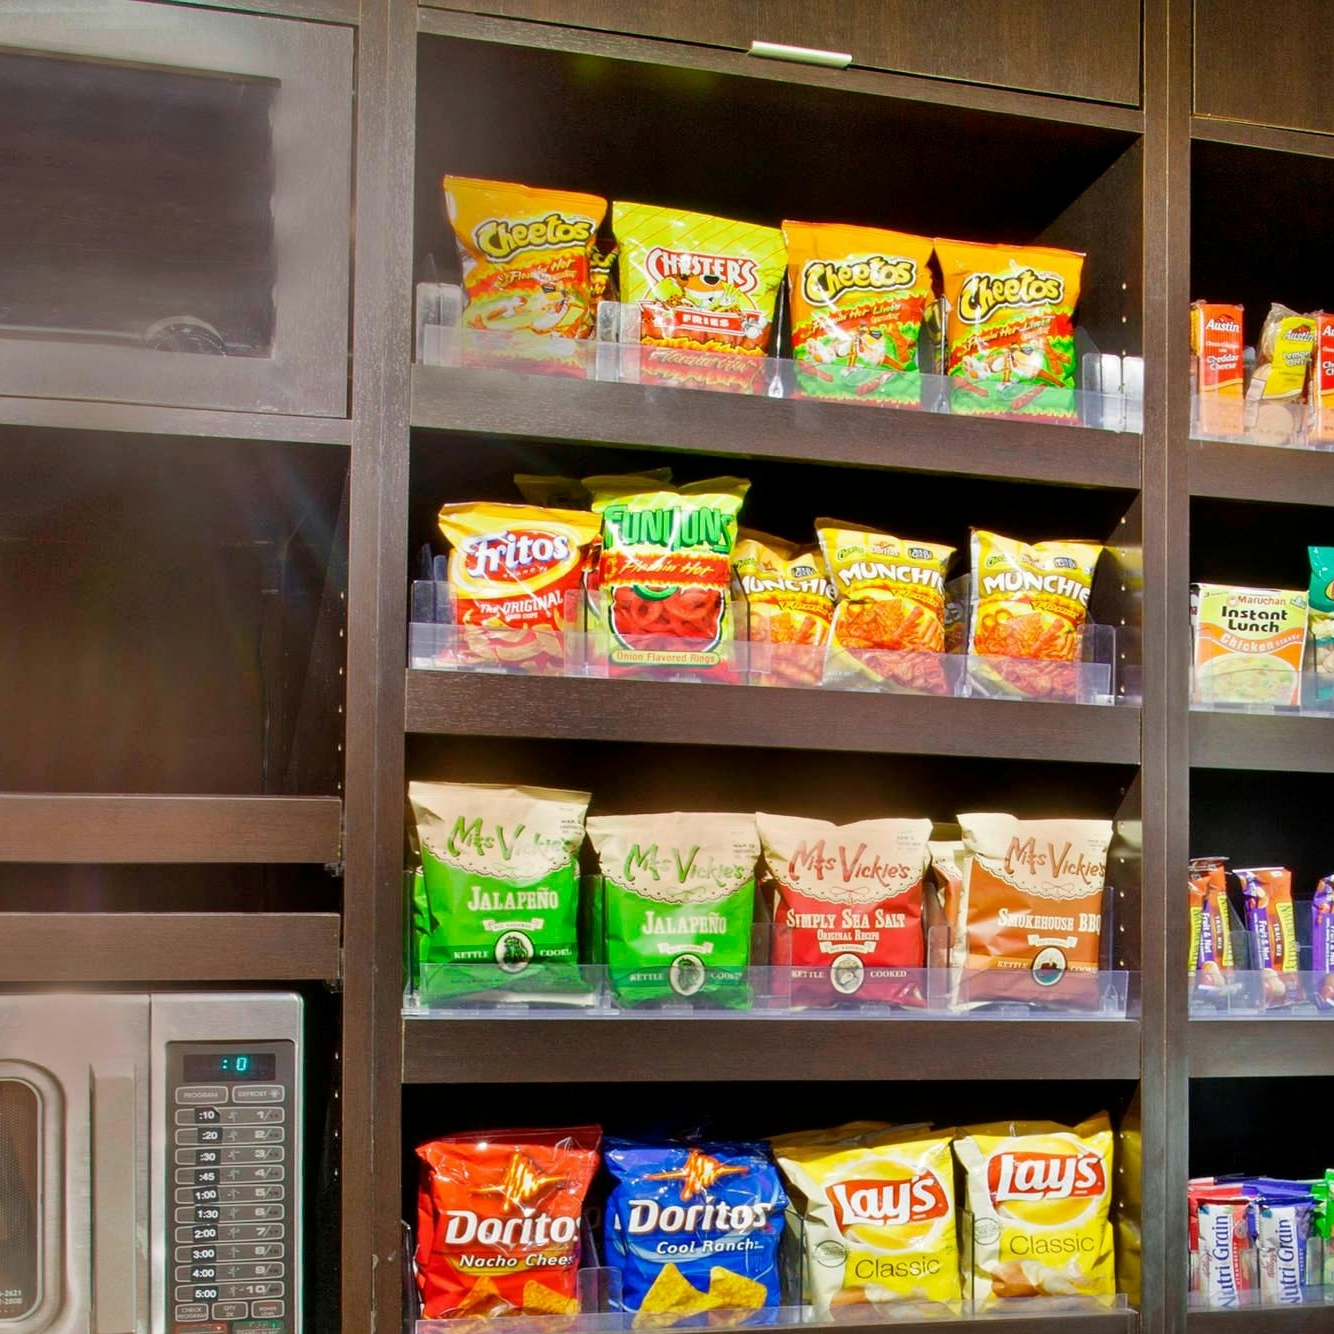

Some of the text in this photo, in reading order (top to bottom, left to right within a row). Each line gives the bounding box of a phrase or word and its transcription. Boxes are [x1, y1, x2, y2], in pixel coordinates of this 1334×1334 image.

[478, 214, 592, 258] Cheetos
[647, 248, 758, 294] CHESTER'S
[805, 256, 914, 303] Cheetos
[959, 268, 1063, 321] Cheetos
[682, 313, 730, 327] FRIES
[1205, 318, 1240, 333] Austin
[1282, 329, 1316, 343] Austin
[1206, 353, 1240, 366] Cheddar
[1210, 361, 1237, 371] Cheese
[604, 505, 733, 553] FUNYUNS
[463, 531, 569, 577] Fritos
[679, 561, 715, 577] Hot
[502, 589, 563, 615] ORIGINAL
[1238, 595, 1287, 606] Maruchan
[1221, 606, 1288, 621] Instant
[1228, 619, 1280, 633] Lunch
[1219, 633, 1274, 653] Chicken
[616, 650, 715, 664] Onion Flavored Rings
[671, 845, 746, 888] Vickie's
[838, 842, 911, 888] Vickie's
[1047, 841, 1107, 886] Vickie's
[468, 886, 559, 912] JALAPEÑO
[642, 911, 728, 935] JALAPEÑO
[786, 908, 907, 930] SIMPLY SEA SALT
[997, 907, 1074, 931] SMOKEHOUSE
[1202, 912, 1211, 934] Fruit
[817, 929, 880, 942] ORIGINAL RECIPE
[1258, 919, 1267, 938] Fruit
[454, 951, 489, 960] KETTLE
[997, 960, 1028, 969] KETTLE
[630, 972, 665, 982] KETTLE
[791, 969, 908, 979] KETTLE COOKED
[183, 1090, 267, 1099] PROGRAM DEFROST
[199, 1110, 215, 1120] :10
[202, 1130, 218, 1140] :20
[200, 1152, 216, 1162] :30
[199, 1172, 215, 1181] :45
[995, 1152, 1098, 1201] Lay's
[195, 1189, 217, 1200] 1:00
[834, 1175, 938, 1226] Lay's
[197, 1209, 219, 1219] 1:30
[628, 1199, 772, 1234] Doritos
[194, 1228, 216, 1239] 2:00
[657, 1239, 754, 1255] Cool Ranch
[1009, 1234, 1096, 1256] Classic
[193, 1249, 215, 1259] 3:00
[459, 1253, 574, 1268] Nacho Chees
[1212, 1215, 1233, 1307] Nutri Grain
[1278, 1219, 1300, 1304] Nutri Grain
[192, 1268, 215, 1278] 4:00
[854, 1256, 941, 1280] Classic
[194, 1288, 217, 1299] 5:00
